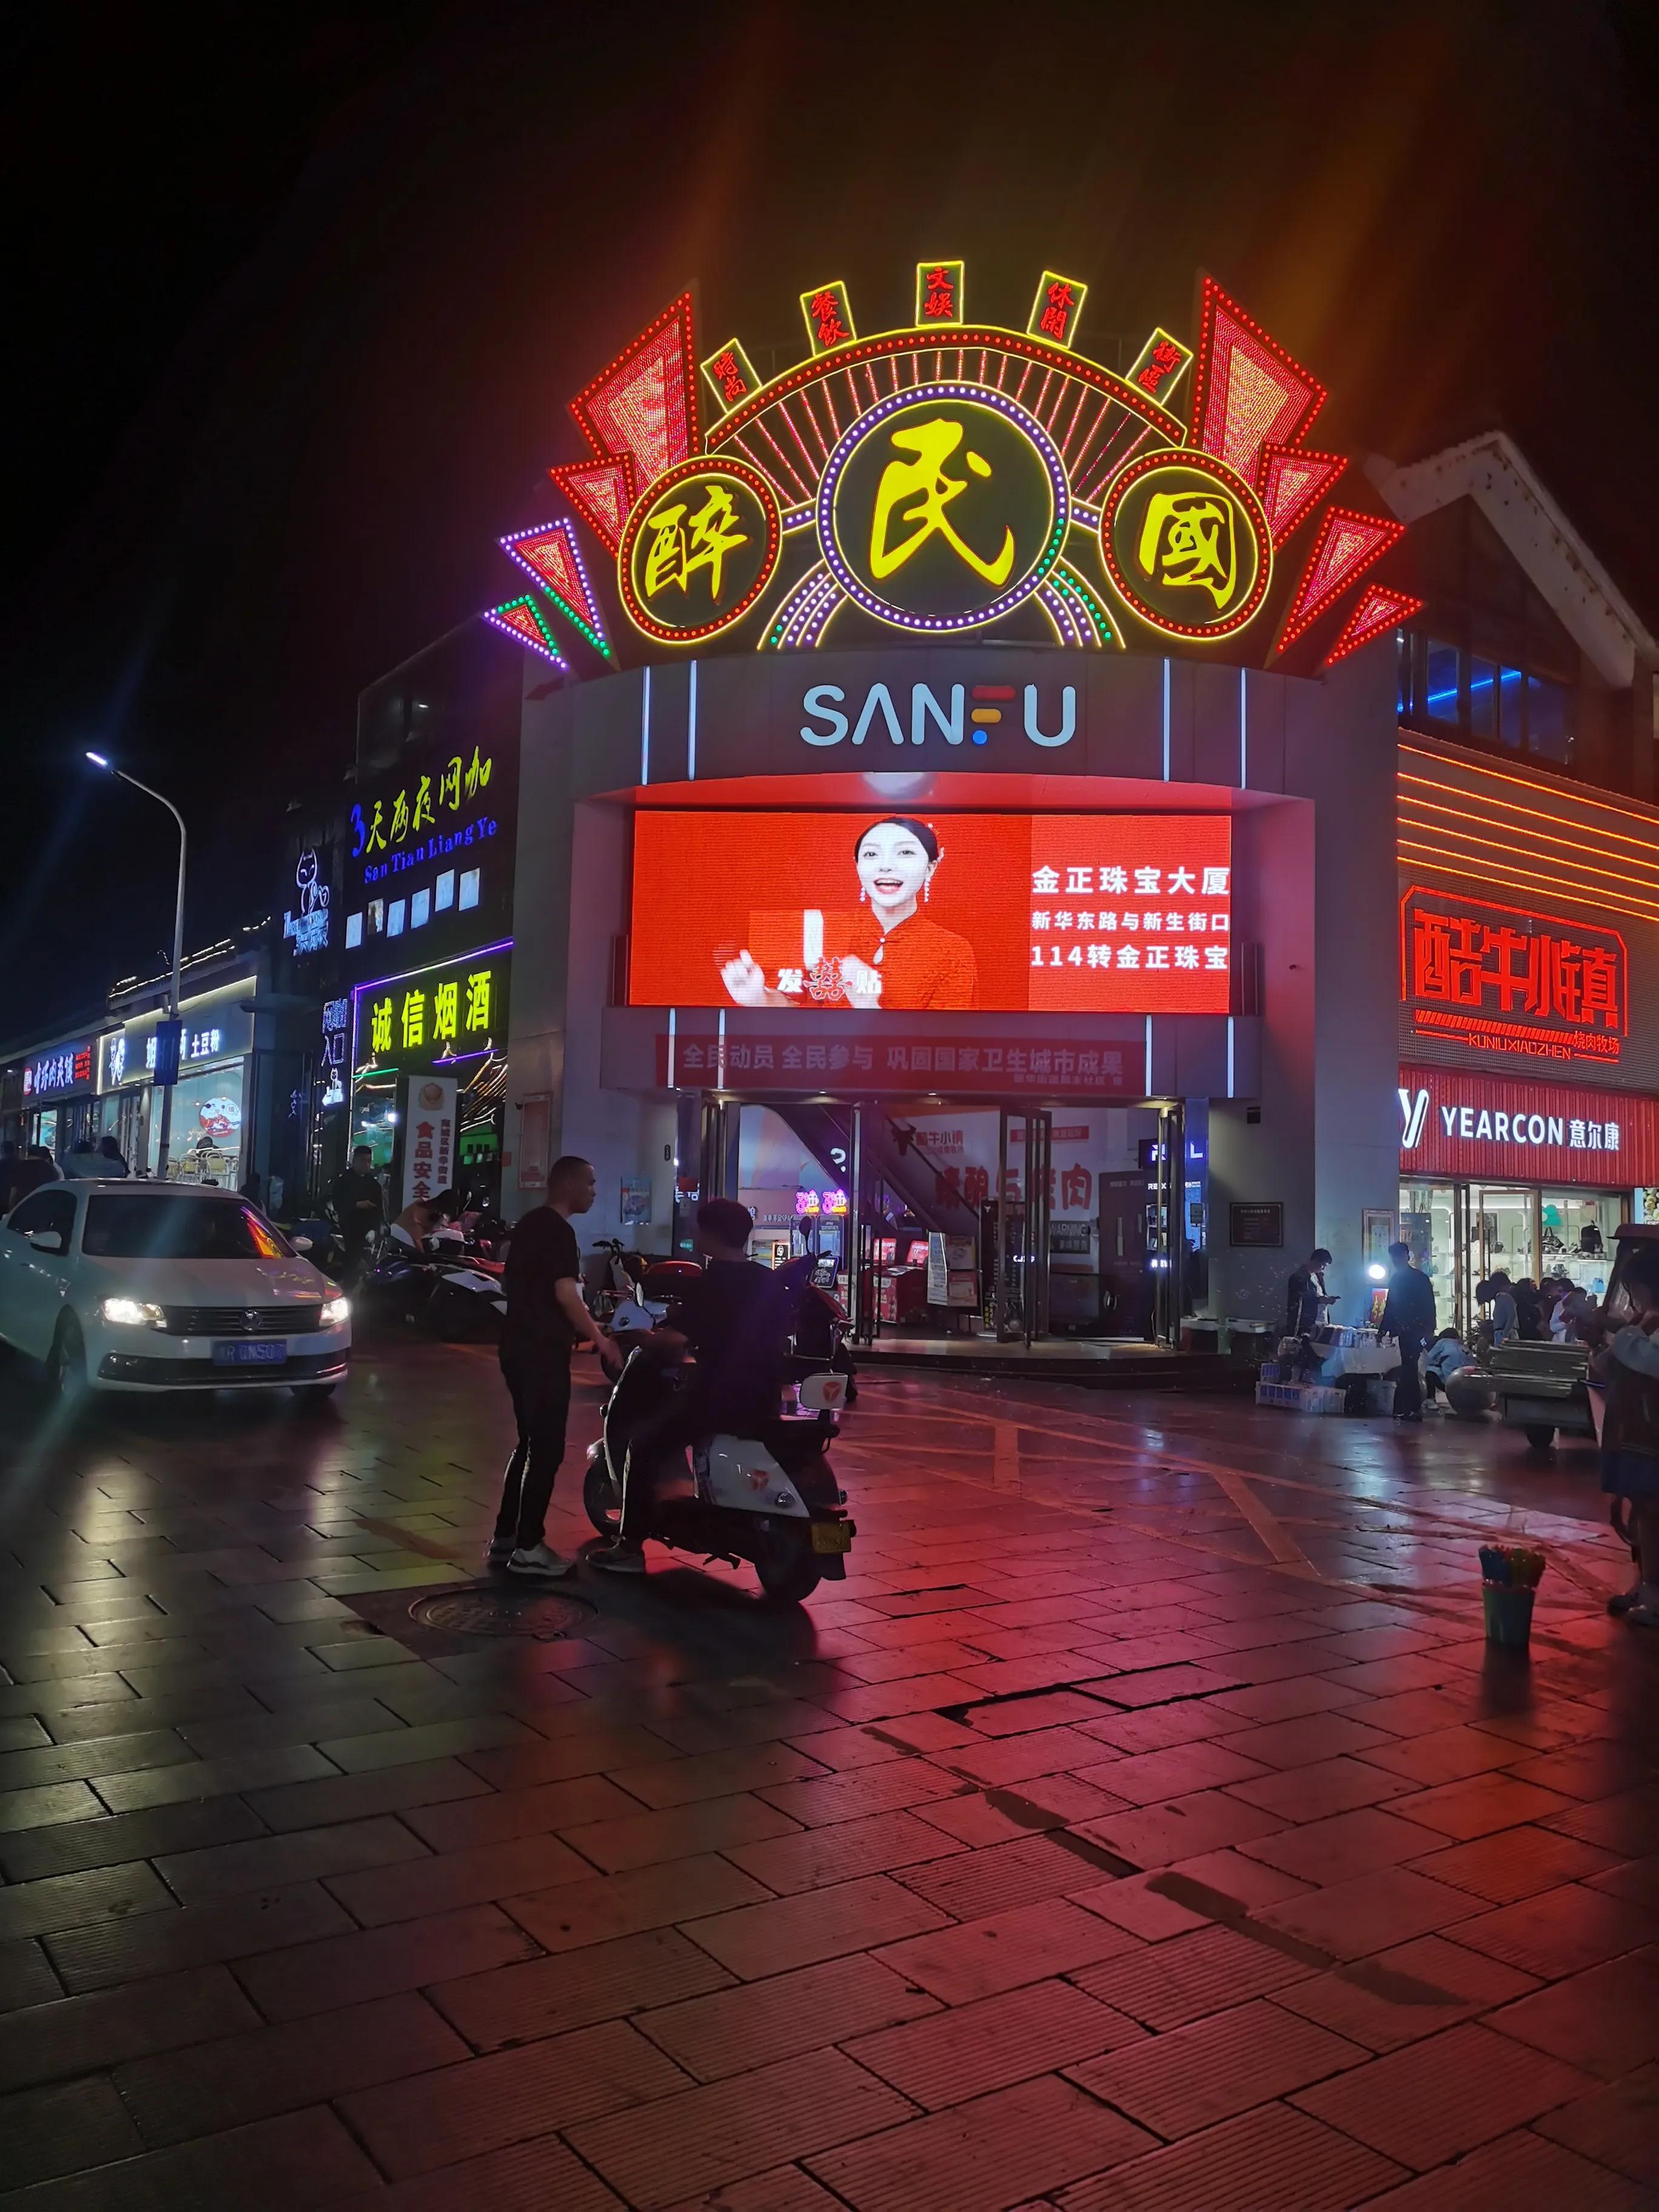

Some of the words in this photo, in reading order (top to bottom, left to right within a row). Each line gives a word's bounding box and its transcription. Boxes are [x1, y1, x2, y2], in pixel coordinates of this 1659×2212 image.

[800, 683, 1076, 747] SANFU
[1032, 865, 1230, 895] 金正珠宝大厦
[1032, 911, 1229, 931] 新华东路与新生街口
[1031, 944, 1228, 970] 114转金正珠宝
[1414, 908, 1618, 1030] 酷牛小镇
[371, 970, 491, 1052] 诚信烟酒
[1469, 1033, 1572, 1060] KUNIUXIAOZHEN
[1574, 1031, 1620, 1055] 烧肉牧场
[683, 1044, 774, 1069] 全民动员
[782, 1045, 874, 1070] 全民参与
[887, 1047, 1123, 1075] 巩固国家卫生城市成果
[1441, 1106, 1563, 1146] YEARCON
[1569, 1119, 1620, 1151] 意尔康
